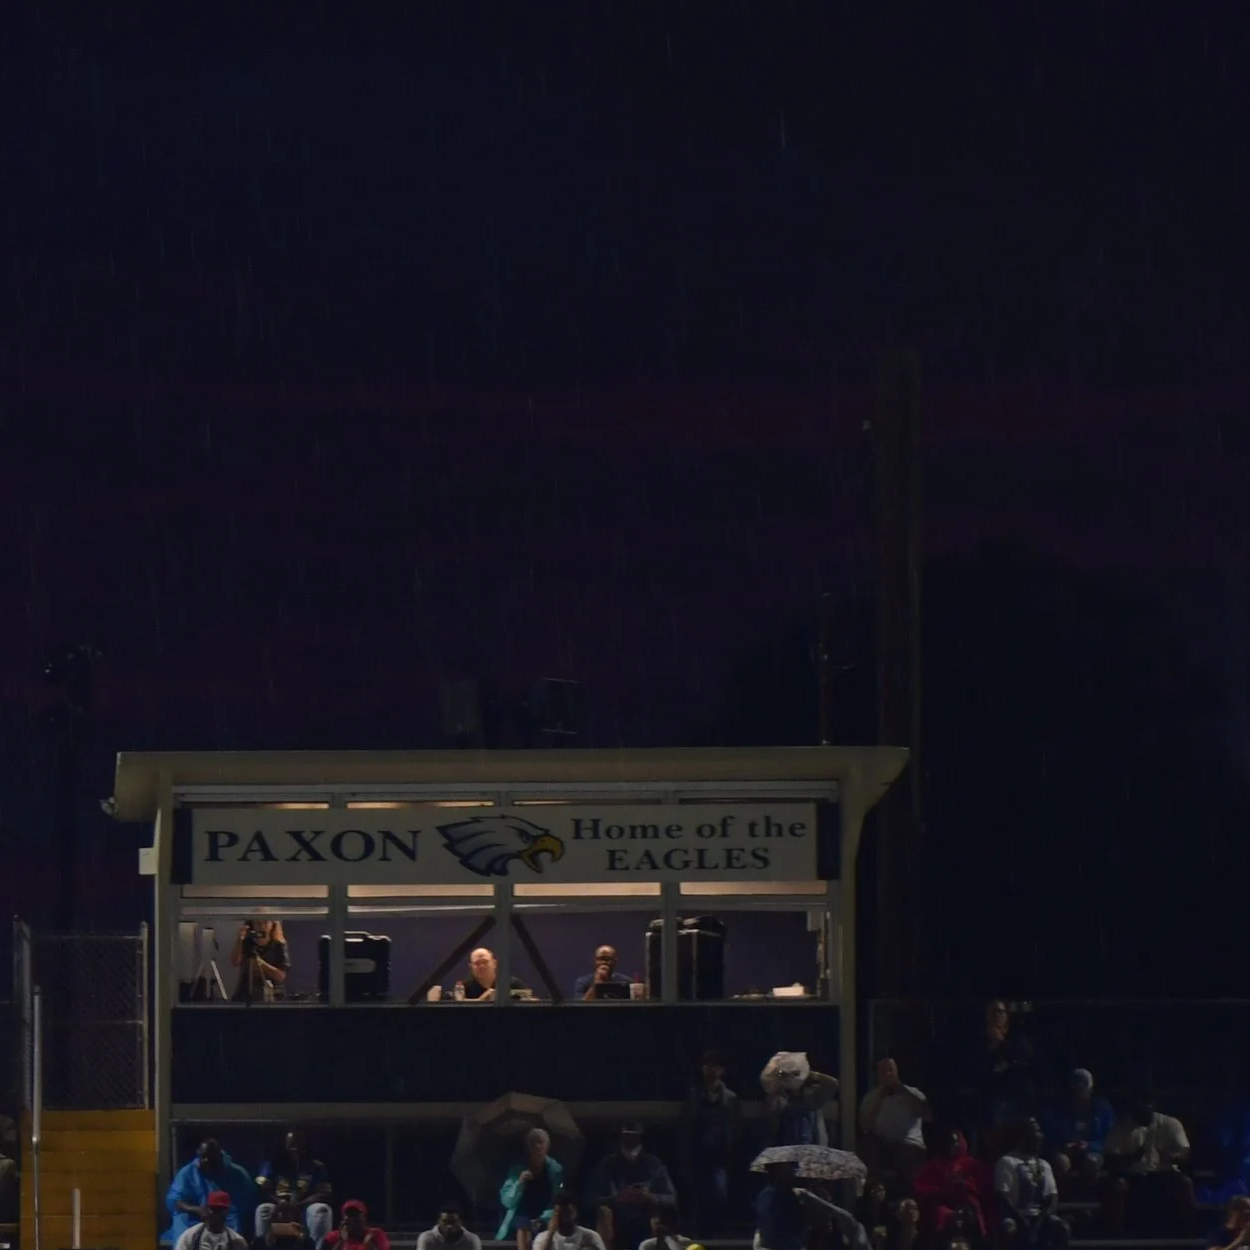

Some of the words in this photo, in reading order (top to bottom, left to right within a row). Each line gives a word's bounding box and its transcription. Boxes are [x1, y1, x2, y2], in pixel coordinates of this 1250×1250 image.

[571, 817, 683, 840] Home
[696, 815, 735, 839] of
[747, 815, 807, 838] the
[205, 829, 422, 862] PAXON
[605, 847, 771, 872] EAGLES
